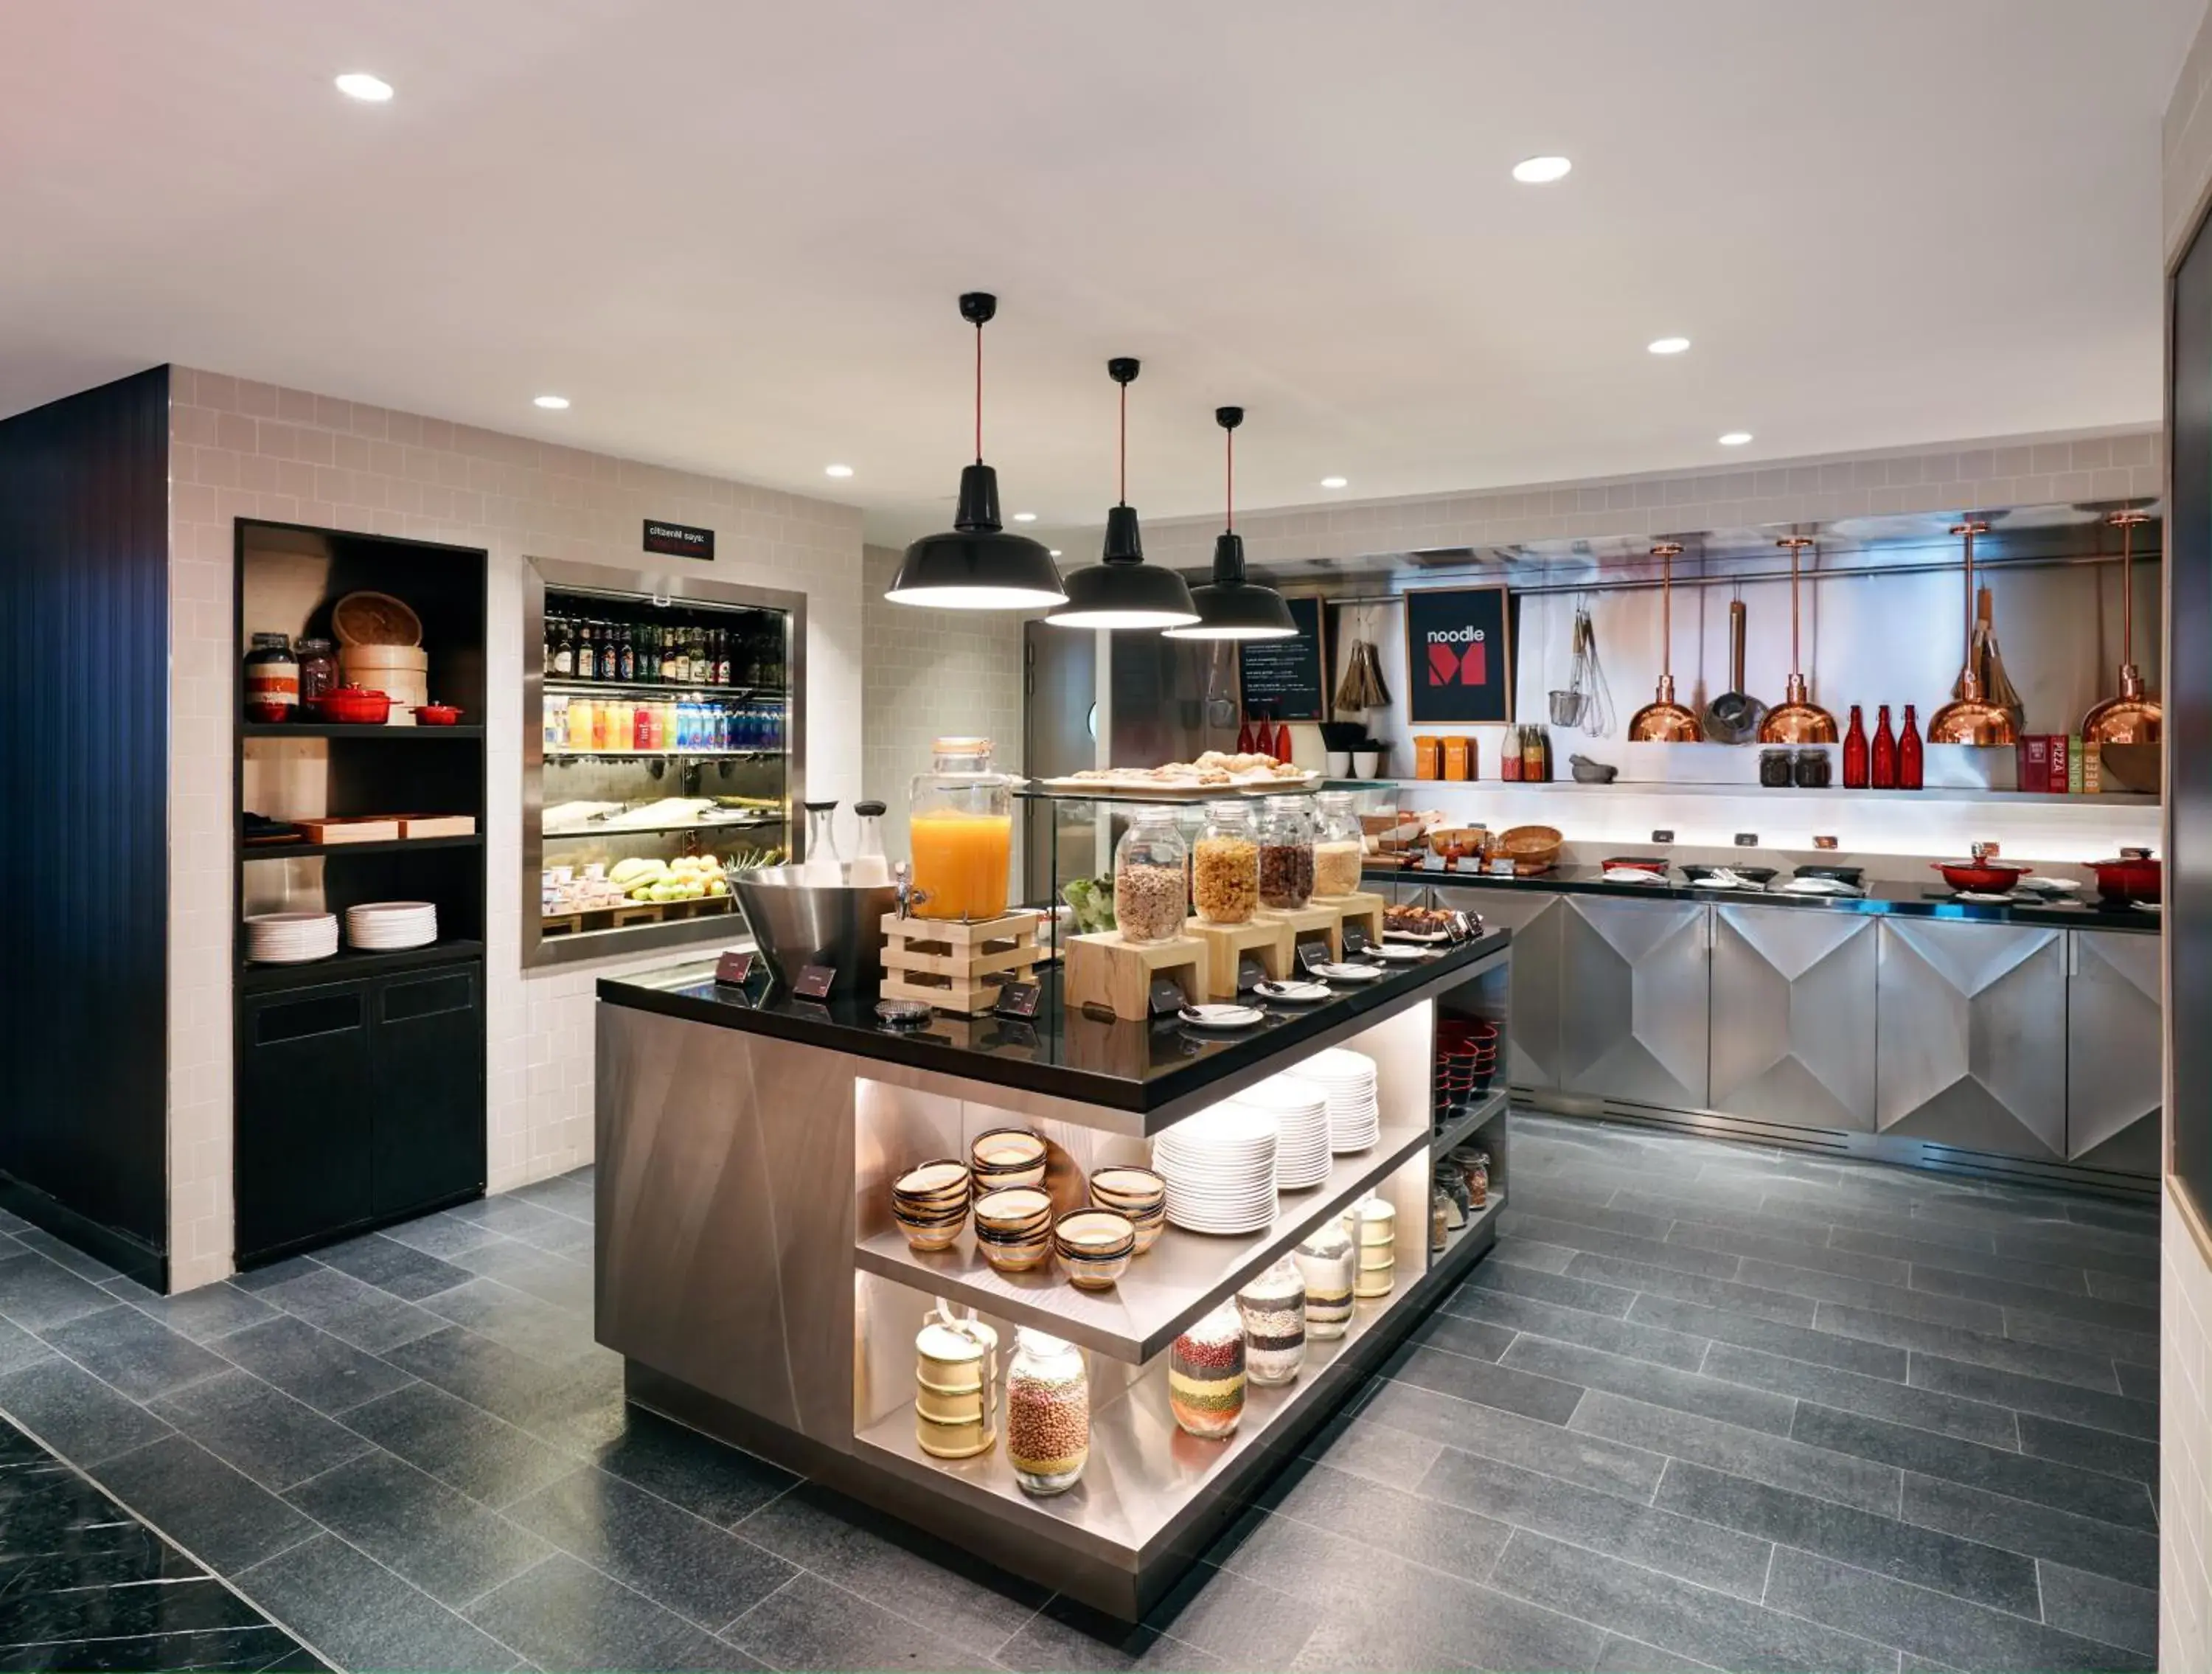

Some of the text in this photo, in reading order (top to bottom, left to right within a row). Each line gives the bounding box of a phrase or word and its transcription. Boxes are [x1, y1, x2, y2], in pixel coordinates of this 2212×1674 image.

[650, 527, 682, 538] citizenM
[1427, 625, 1484, 643] noodle
[2052, 743, 2065, 774] PIZZA
[2085, 755, 2098, 788] BEER
